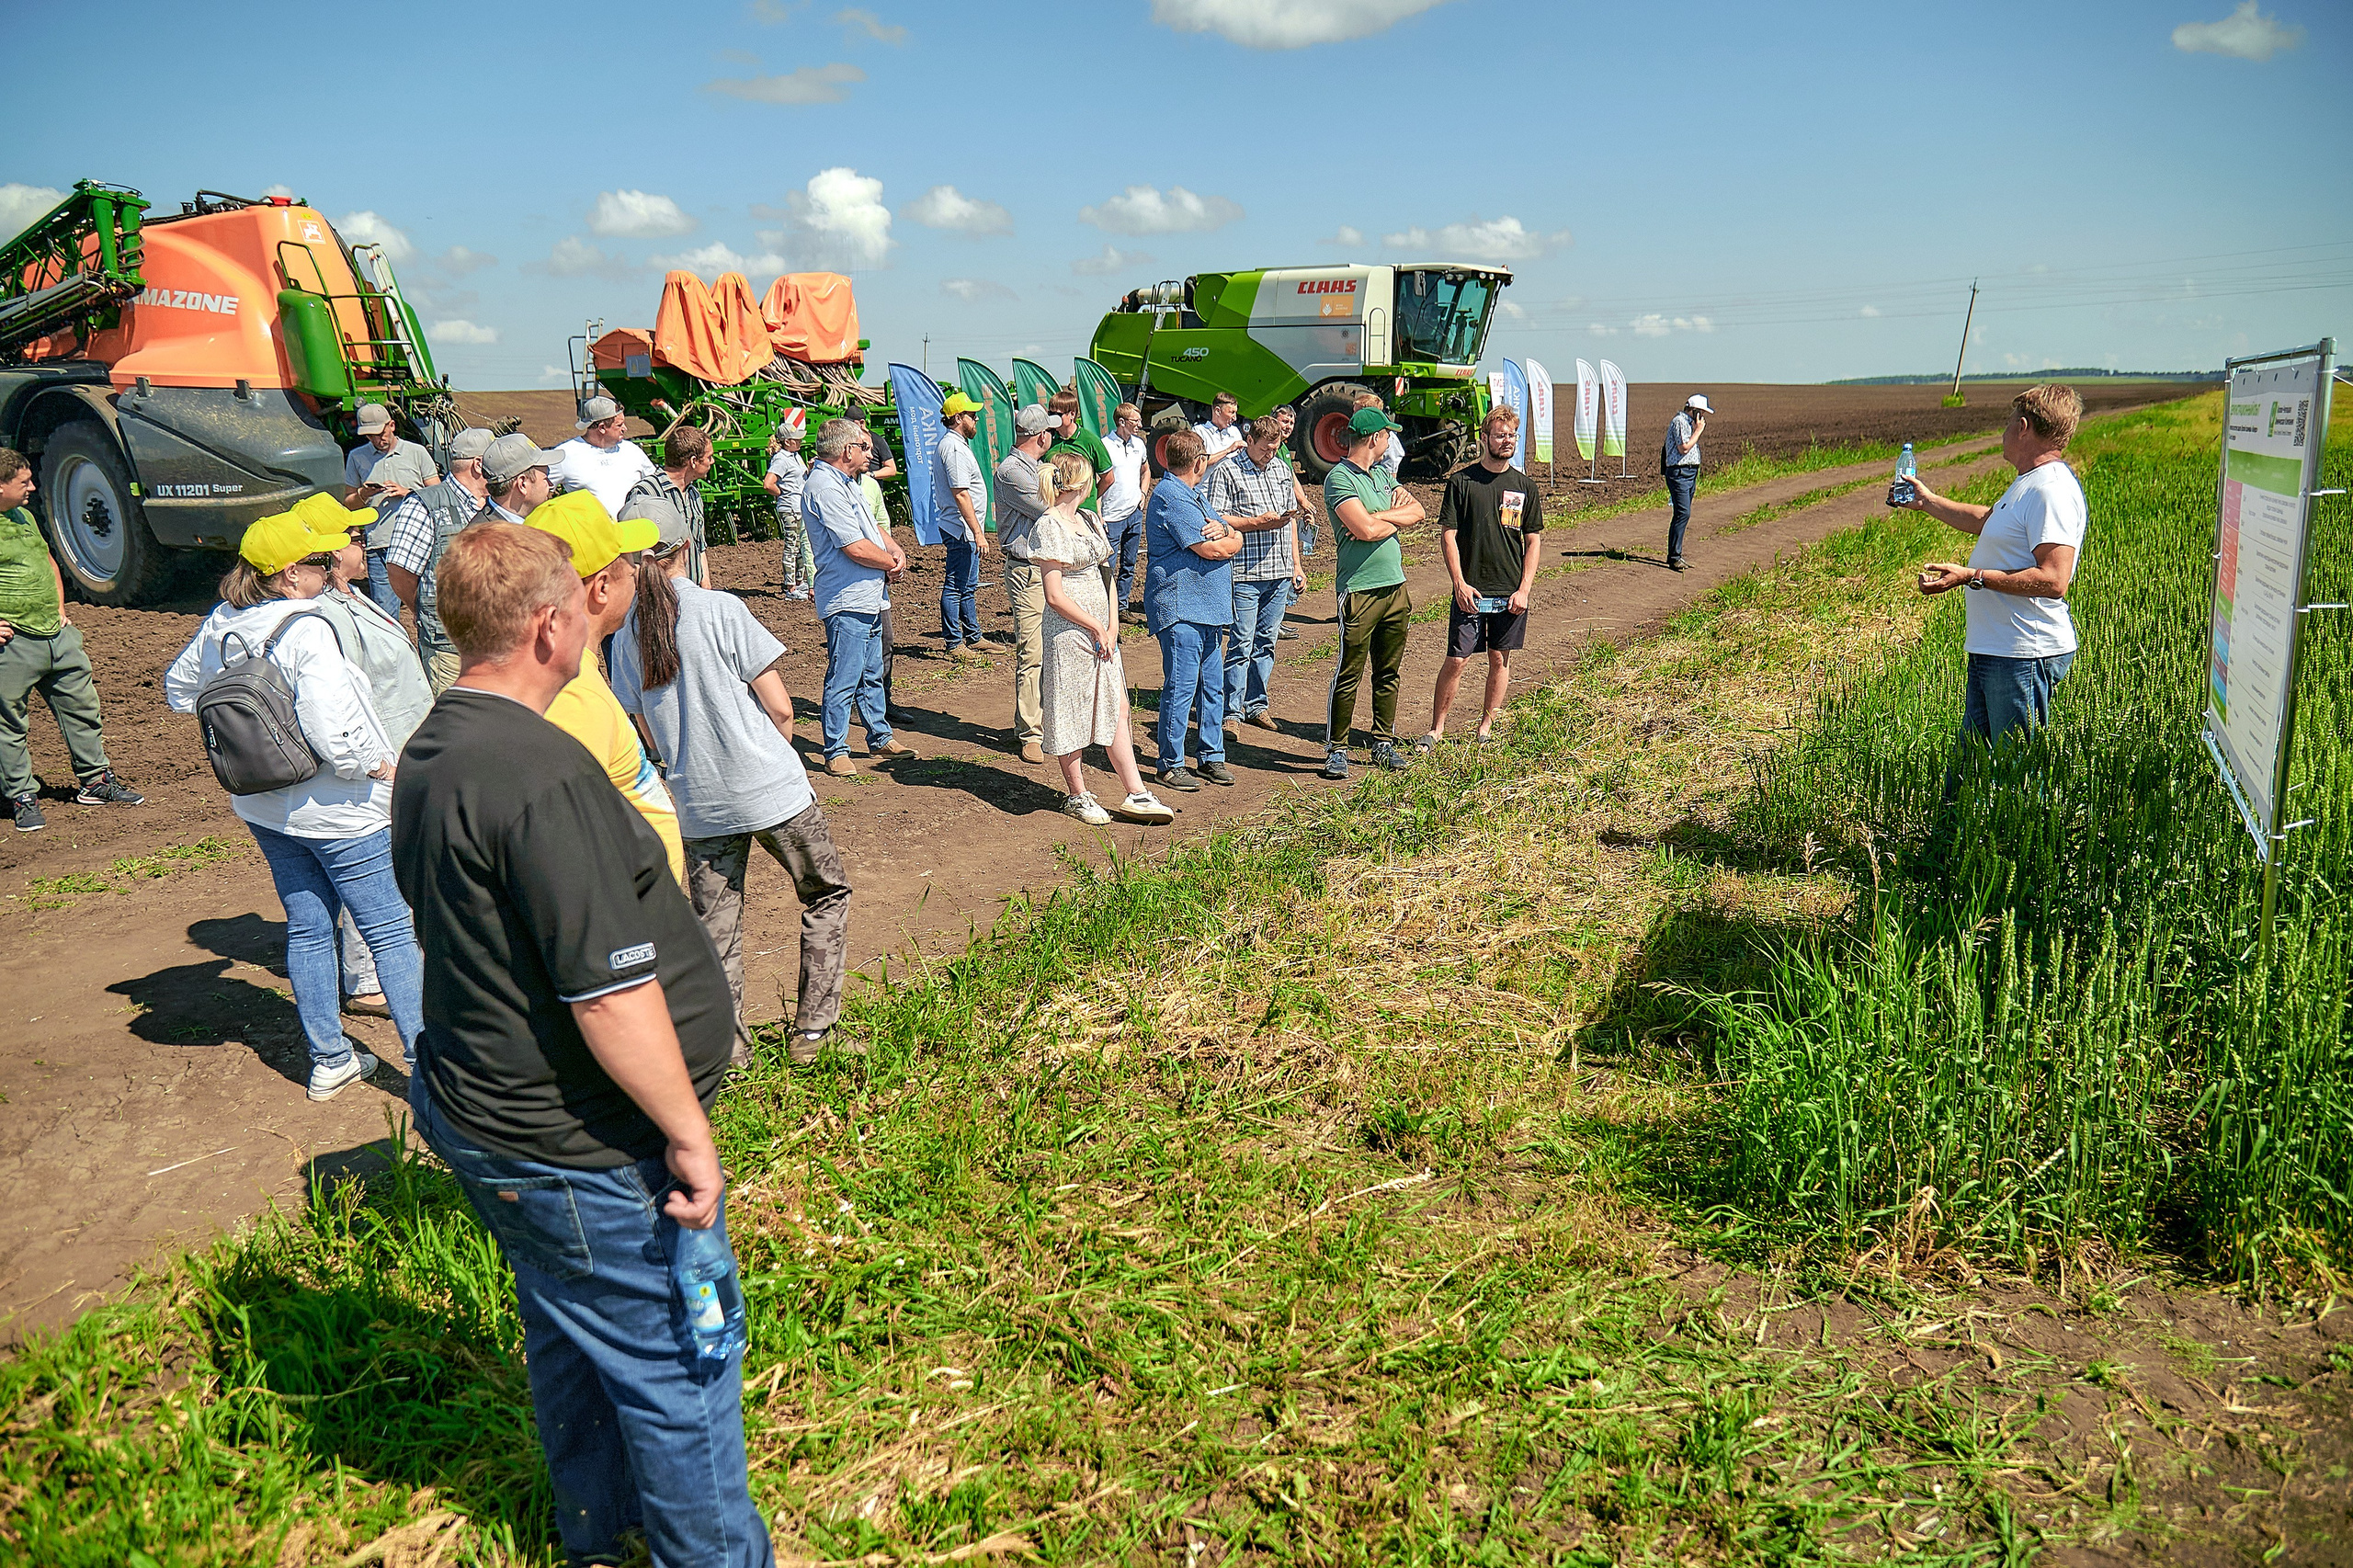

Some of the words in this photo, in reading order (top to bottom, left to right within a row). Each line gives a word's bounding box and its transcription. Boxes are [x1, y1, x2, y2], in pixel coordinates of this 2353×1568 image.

[1297, 279, 1357, 294] CLAAS
[1183, 347, 1210, 357] 450
[157, 484, 175, 497] UX
[176, 484, 210, 496] 11201
[212, 484, 244, 494] Super
[616, 947, 654, 964] LACOSTE
